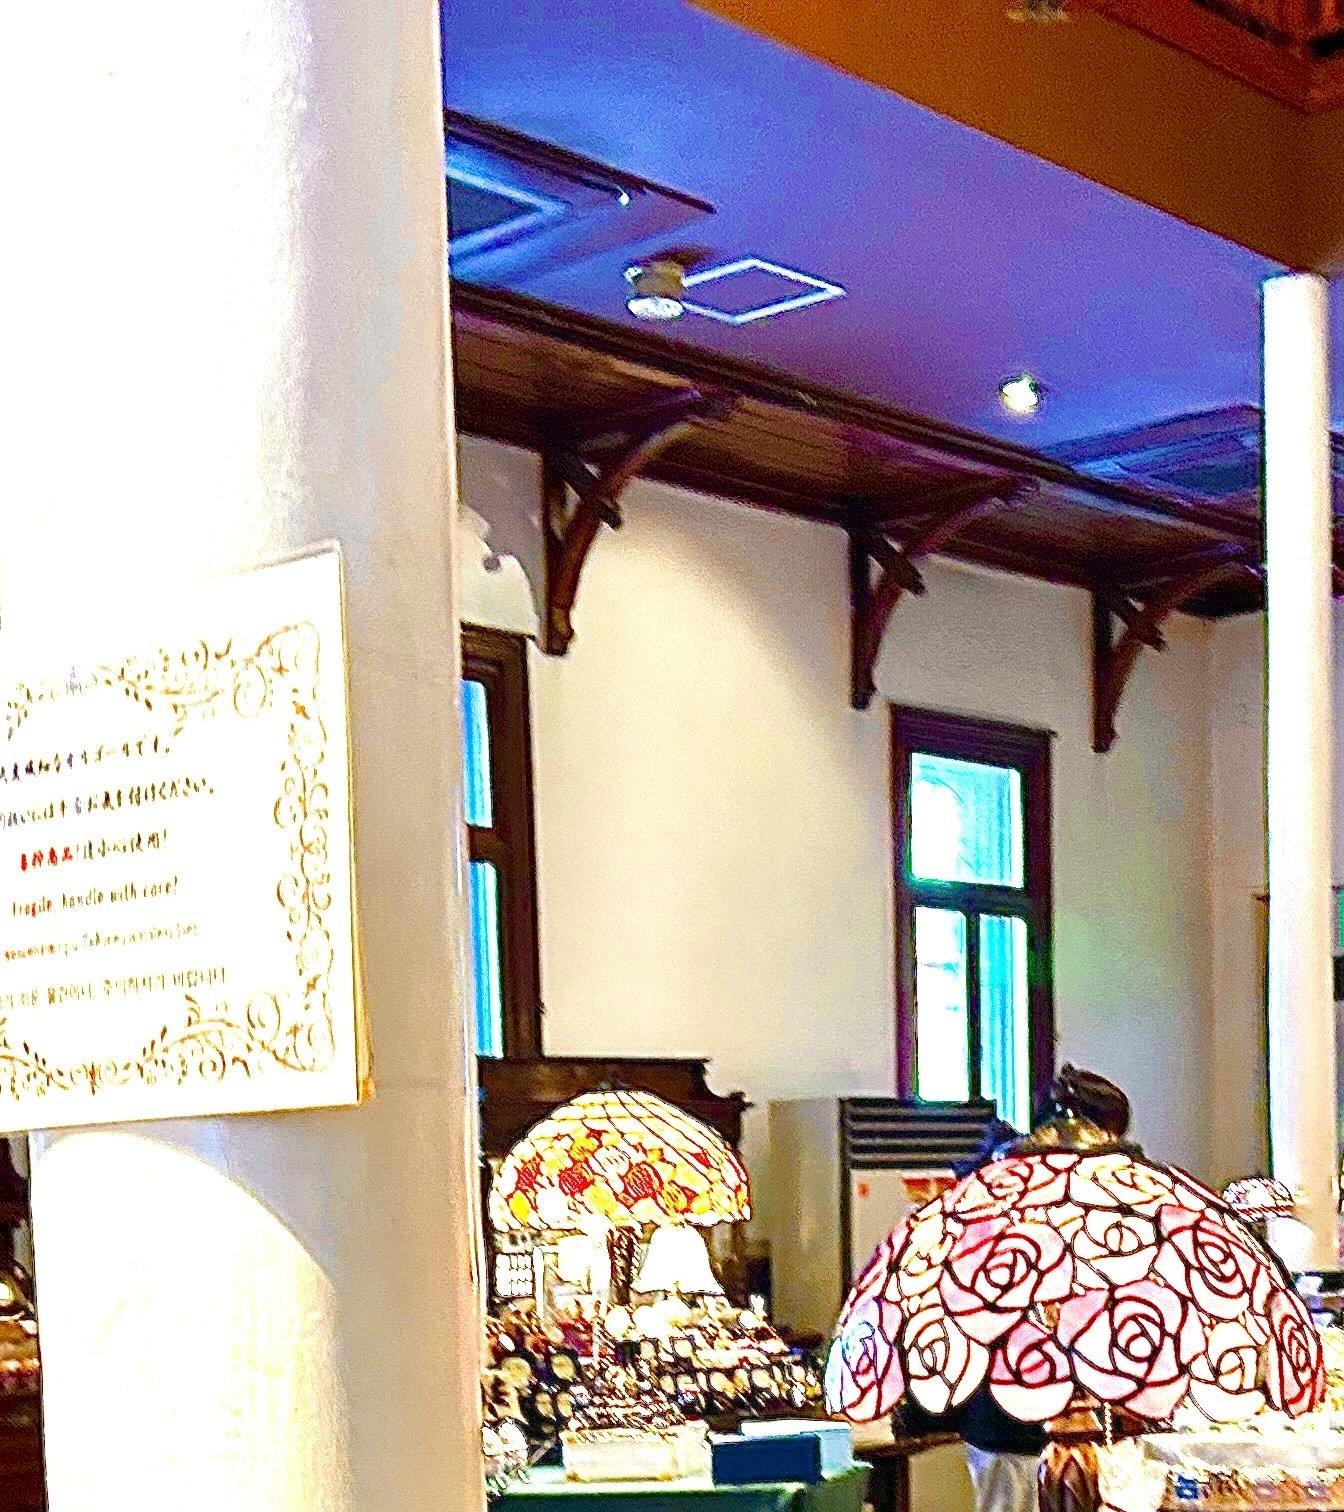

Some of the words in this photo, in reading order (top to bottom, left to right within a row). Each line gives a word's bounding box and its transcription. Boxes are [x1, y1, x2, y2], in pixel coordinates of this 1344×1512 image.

[61, 887, 103, 909] handle
[110, 882, 136, 902] with
[143, 874, 178, 898] care!
